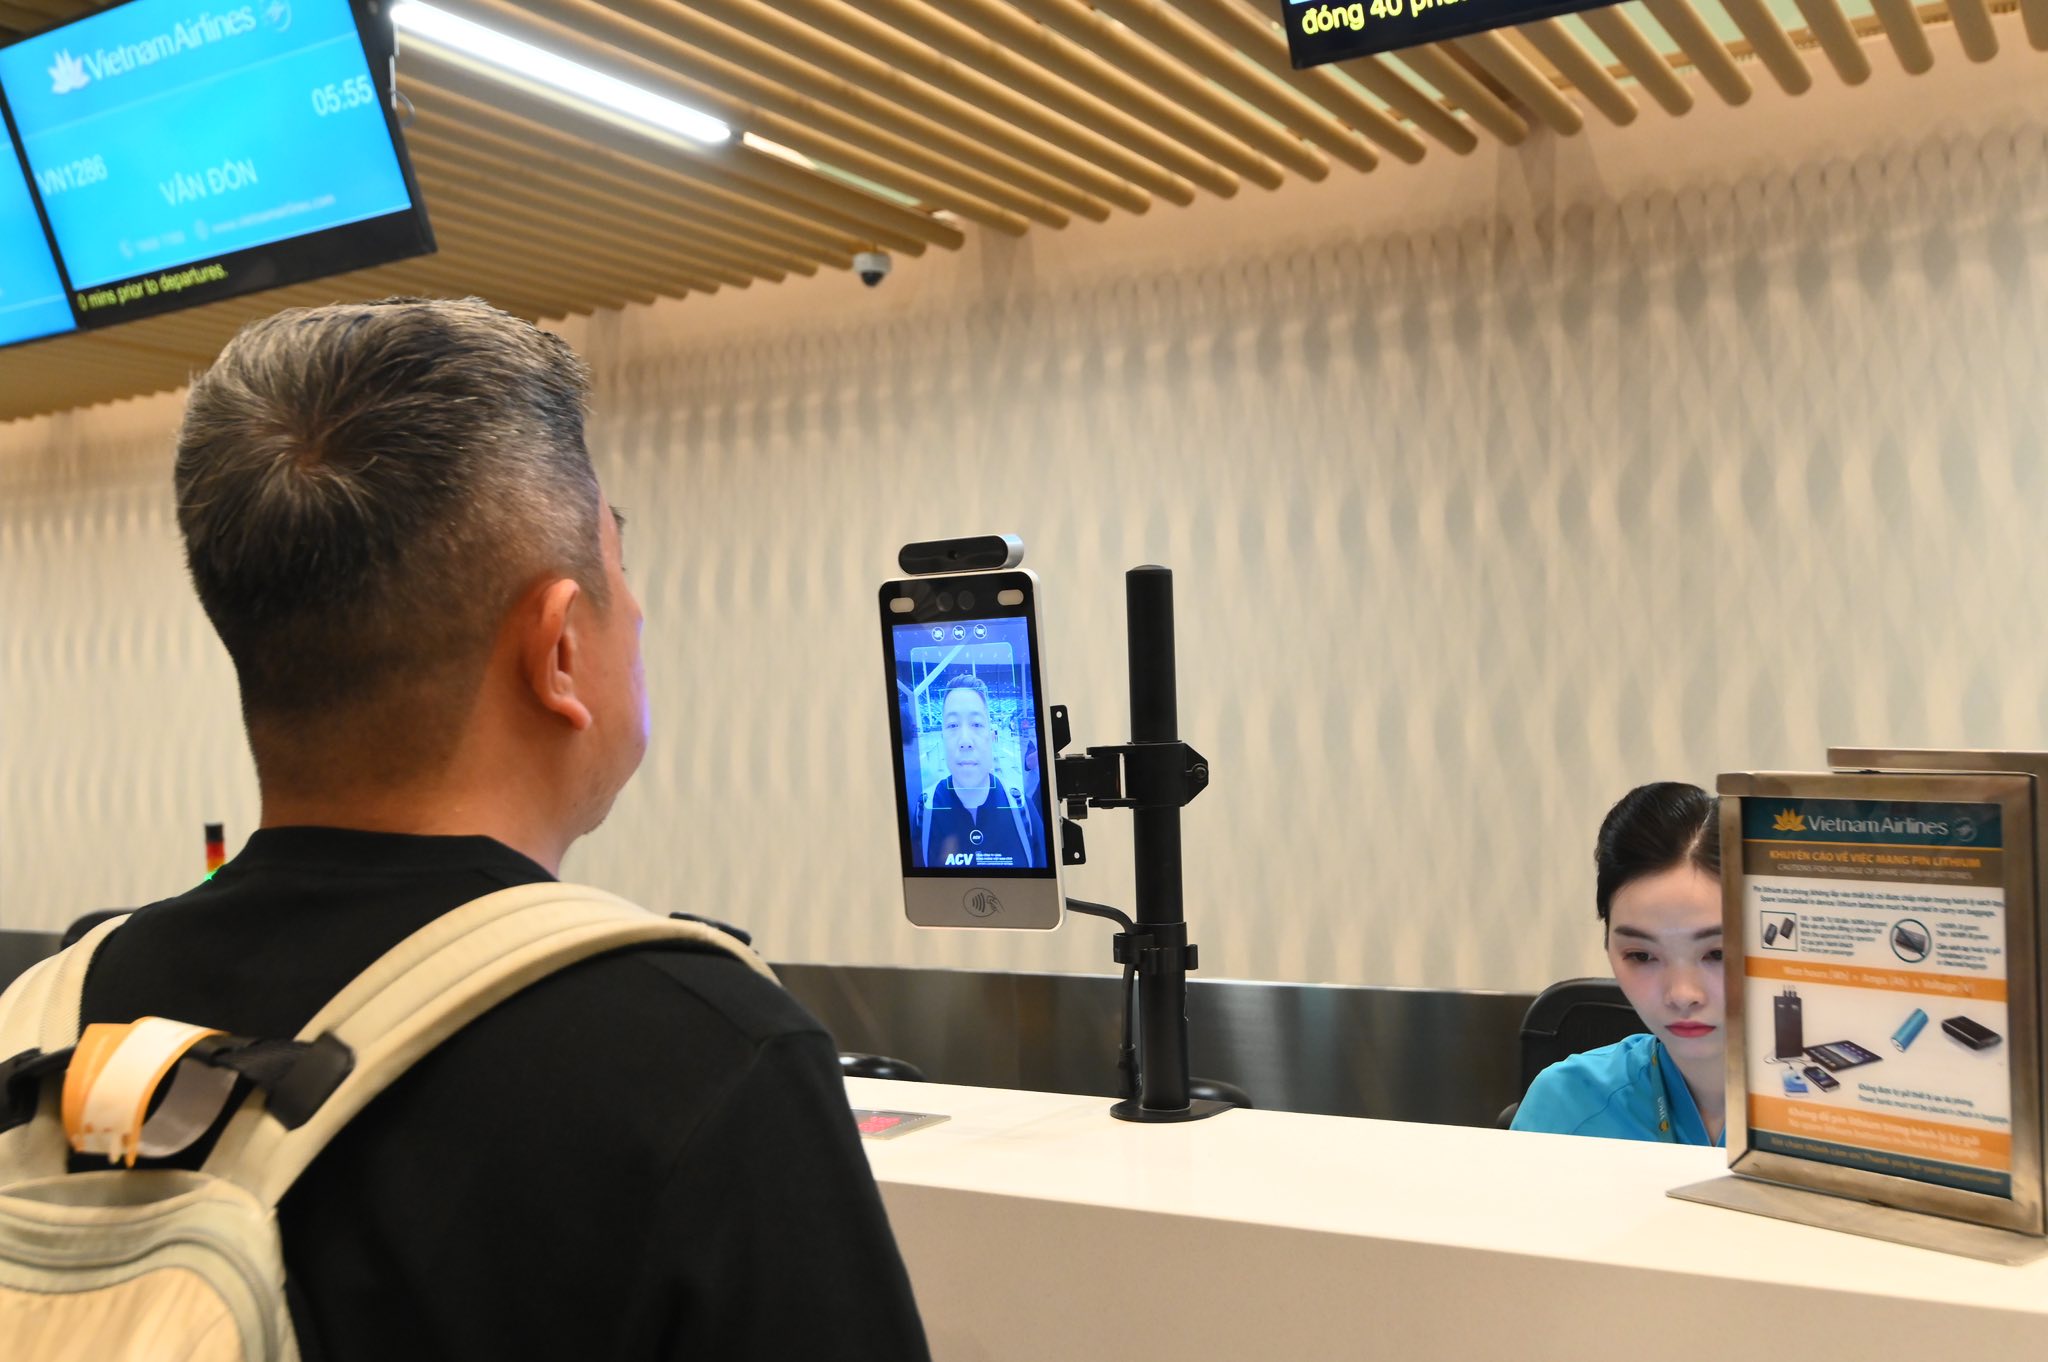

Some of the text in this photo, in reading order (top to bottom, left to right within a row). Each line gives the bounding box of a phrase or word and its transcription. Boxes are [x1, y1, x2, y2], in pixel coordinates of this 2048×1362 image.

[1302, 3, 1365, 35] đóng
[311, 75, 373, 117] 05:55
[88, 289, 117, 308] mins
[117, 282, 144, 305] prior
[144, 278, 159, 295] to
[1808, 815, 1948, 836] Vietnam Airlines
[945, 853, 973, 866] ACV
